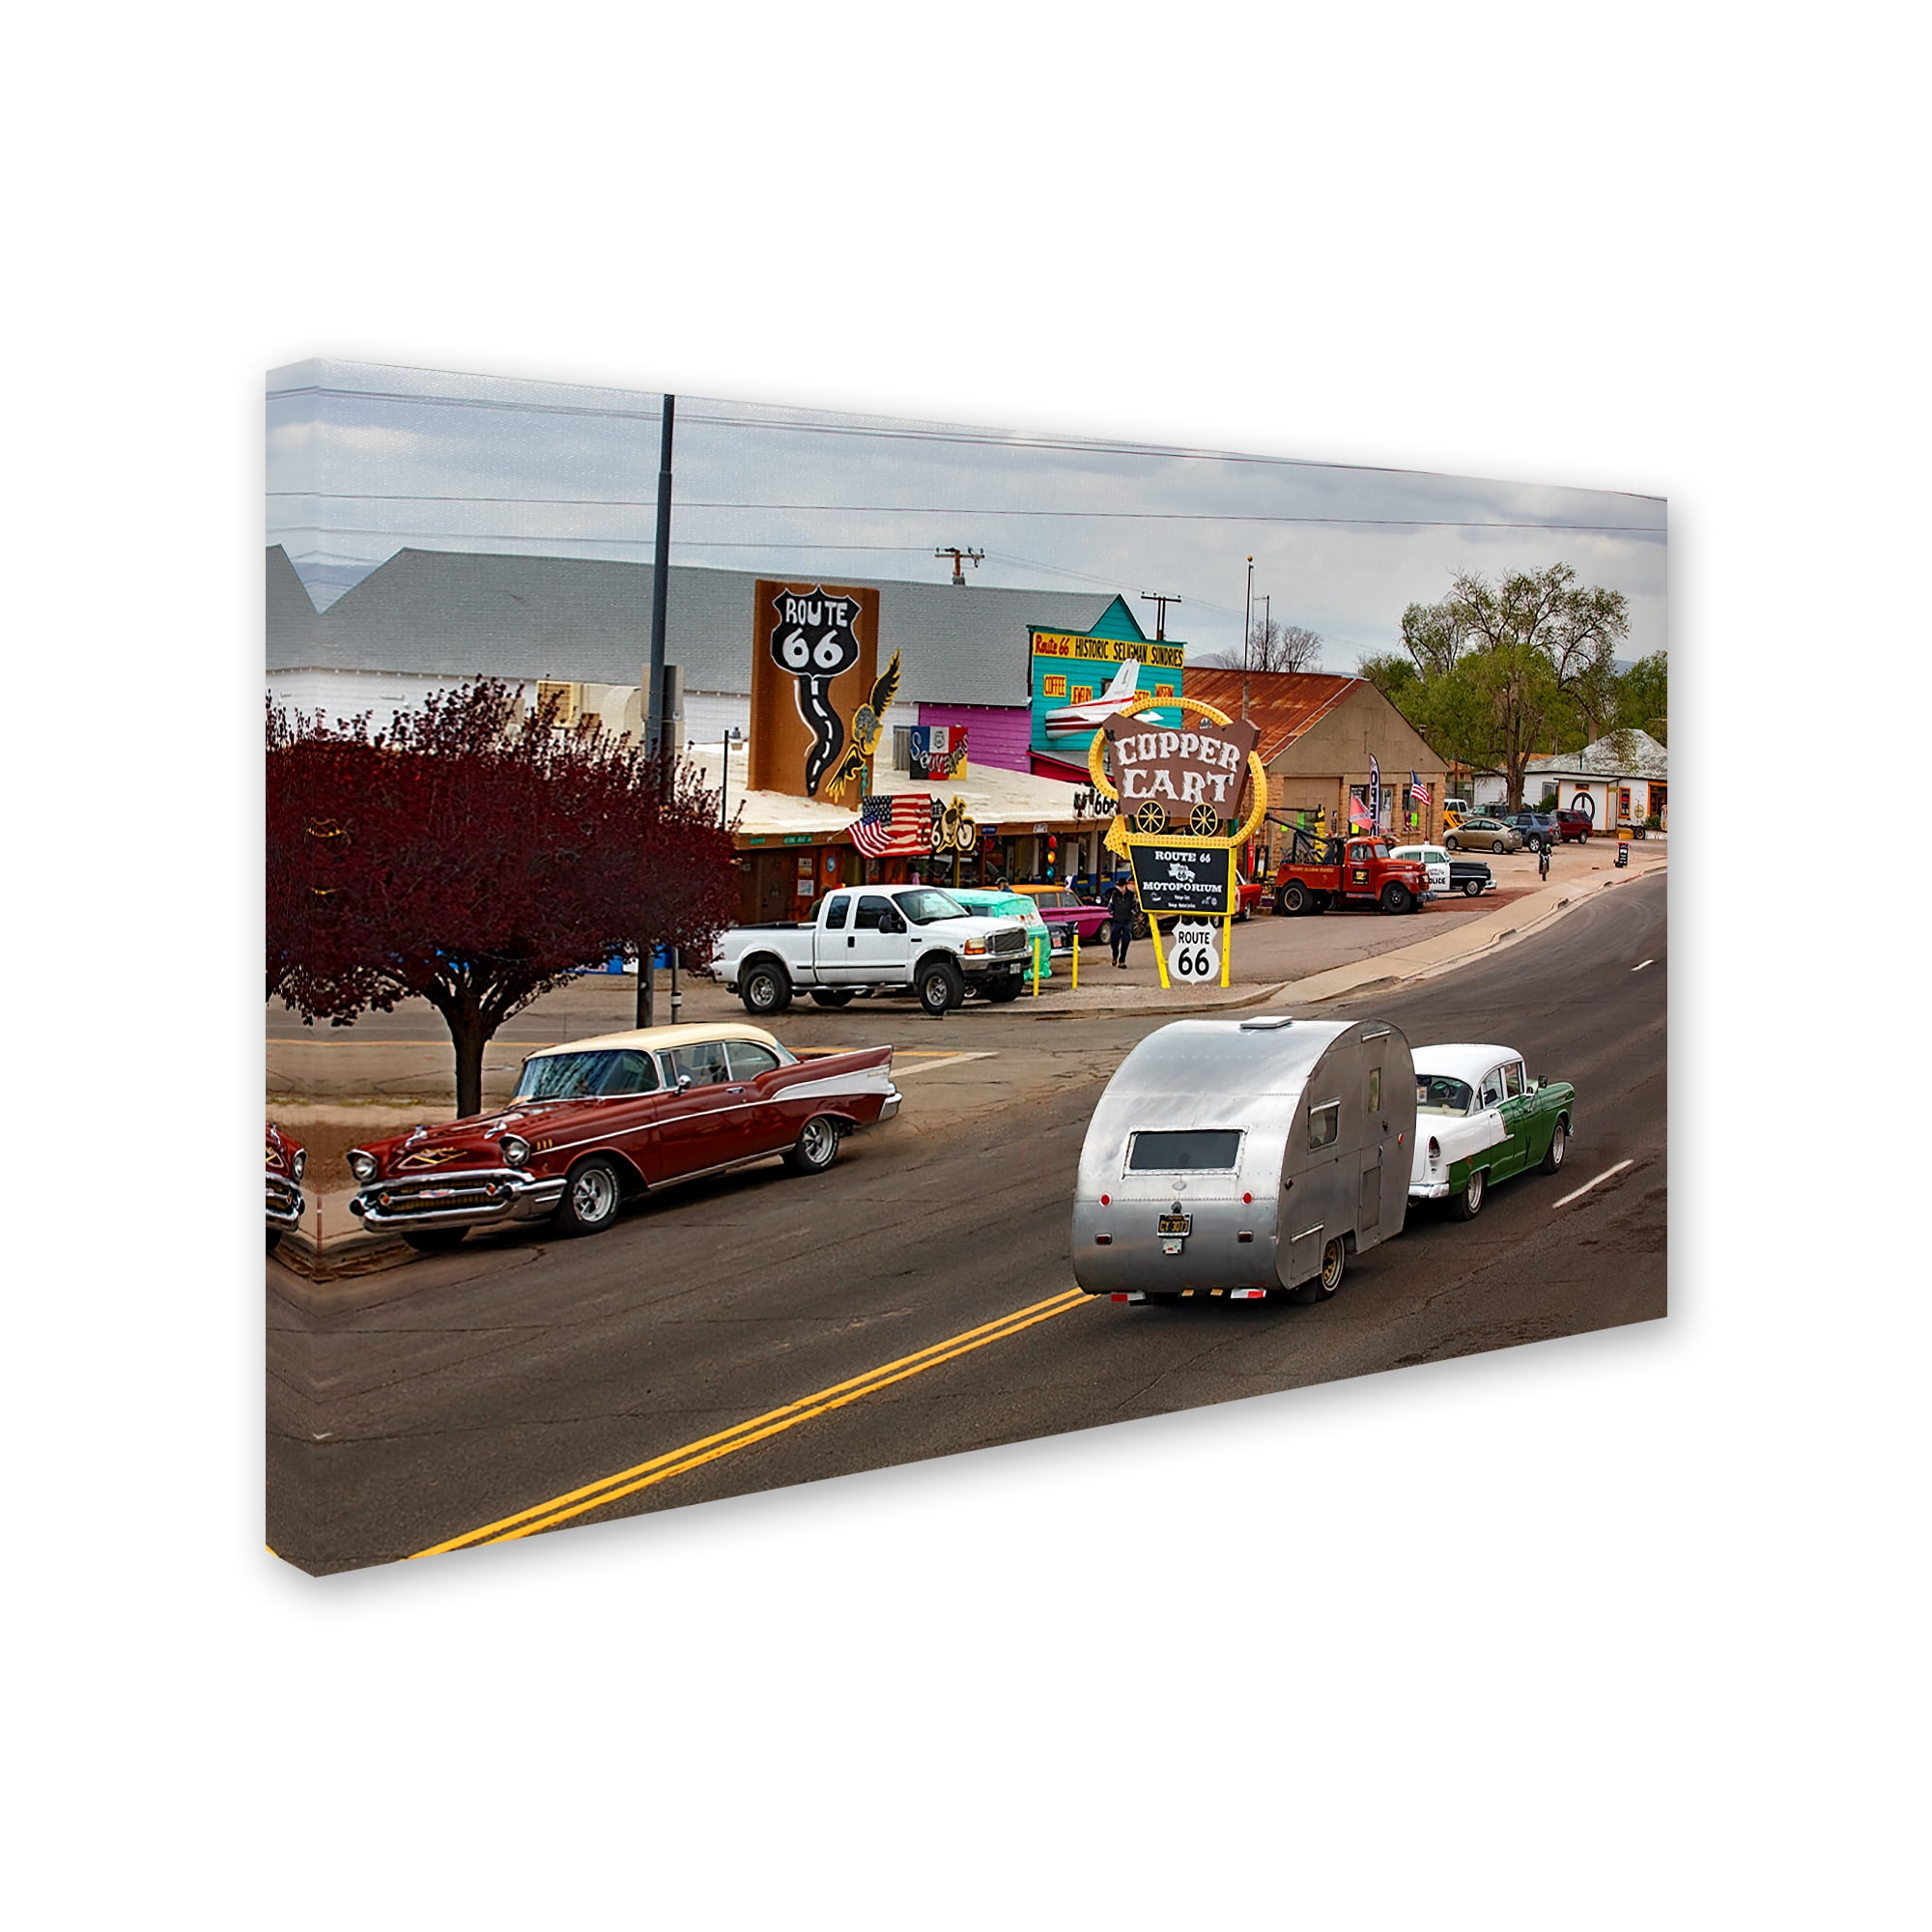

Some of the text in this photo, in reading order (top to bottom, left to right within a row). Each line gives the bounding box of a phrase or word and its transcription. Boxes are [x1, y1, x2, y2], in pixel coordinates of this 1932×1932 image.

[785, 597, 848, 627] ROUTE
[782, 628, 843, 668] 66
[1035, 634, 1183, 668] Route 66 HISTORIC SELIGMAN SUNDRIES
[1044, 675, 1065, 696] COFFEE
[1115, 731, 1240, 773] COPPER
[1122, 768, 1236, 804] CART
[1094, 793, 1111, 815] 66
[1154, 850, 1211, 864] ROUTE 66
[1142, 881, 1222, 894] MOTOPORIUM
[1178, 930, 1210, 945] ROUTE
[1178, 947, 1209, 976] 66
